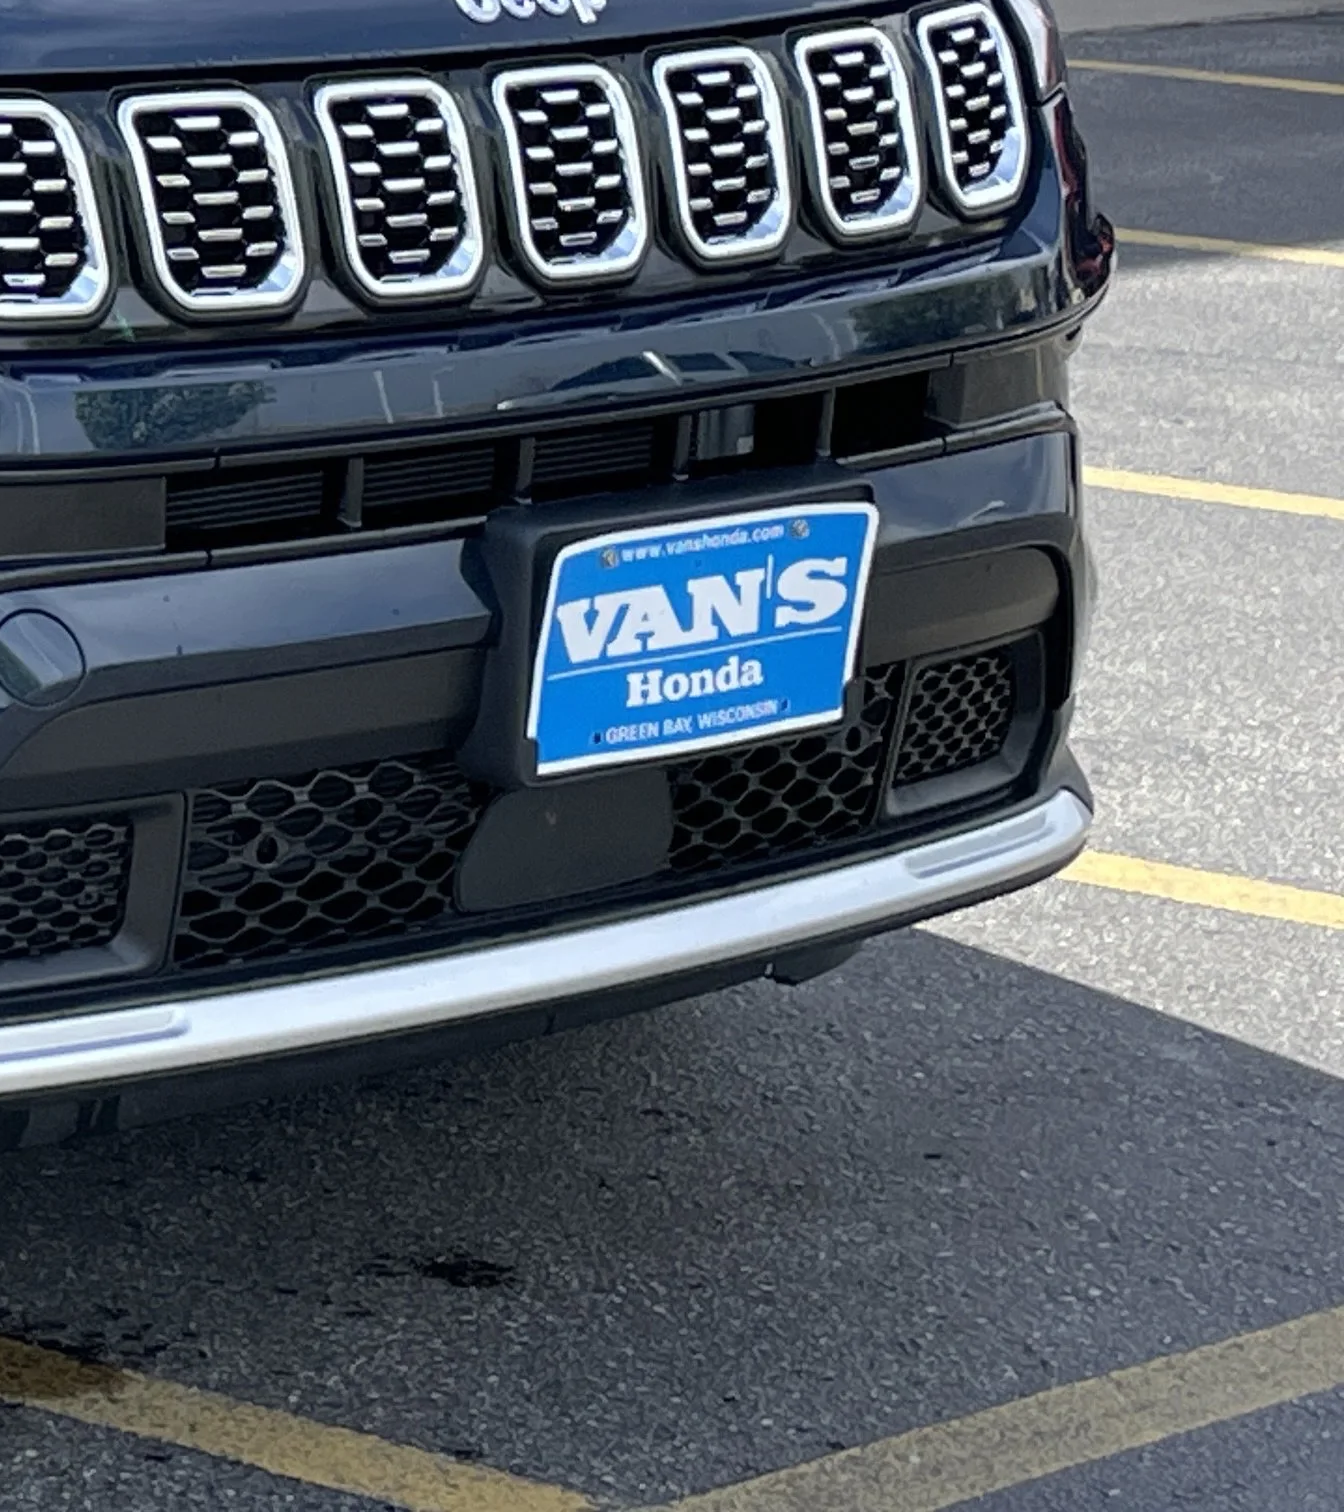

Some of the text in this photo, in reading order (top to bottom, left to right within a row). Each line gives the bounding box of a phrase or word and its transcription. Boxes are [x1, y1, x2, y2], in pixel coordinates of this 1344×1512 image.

[621, 522, 785, 563] www.vanshonda.com
[556, 554, 849, 664] VAN'S
[625, 654, 764, 708] Honda
[604, 721, 659, 745] GREEN
[697, 699, 779, 730] WISCONSIN
